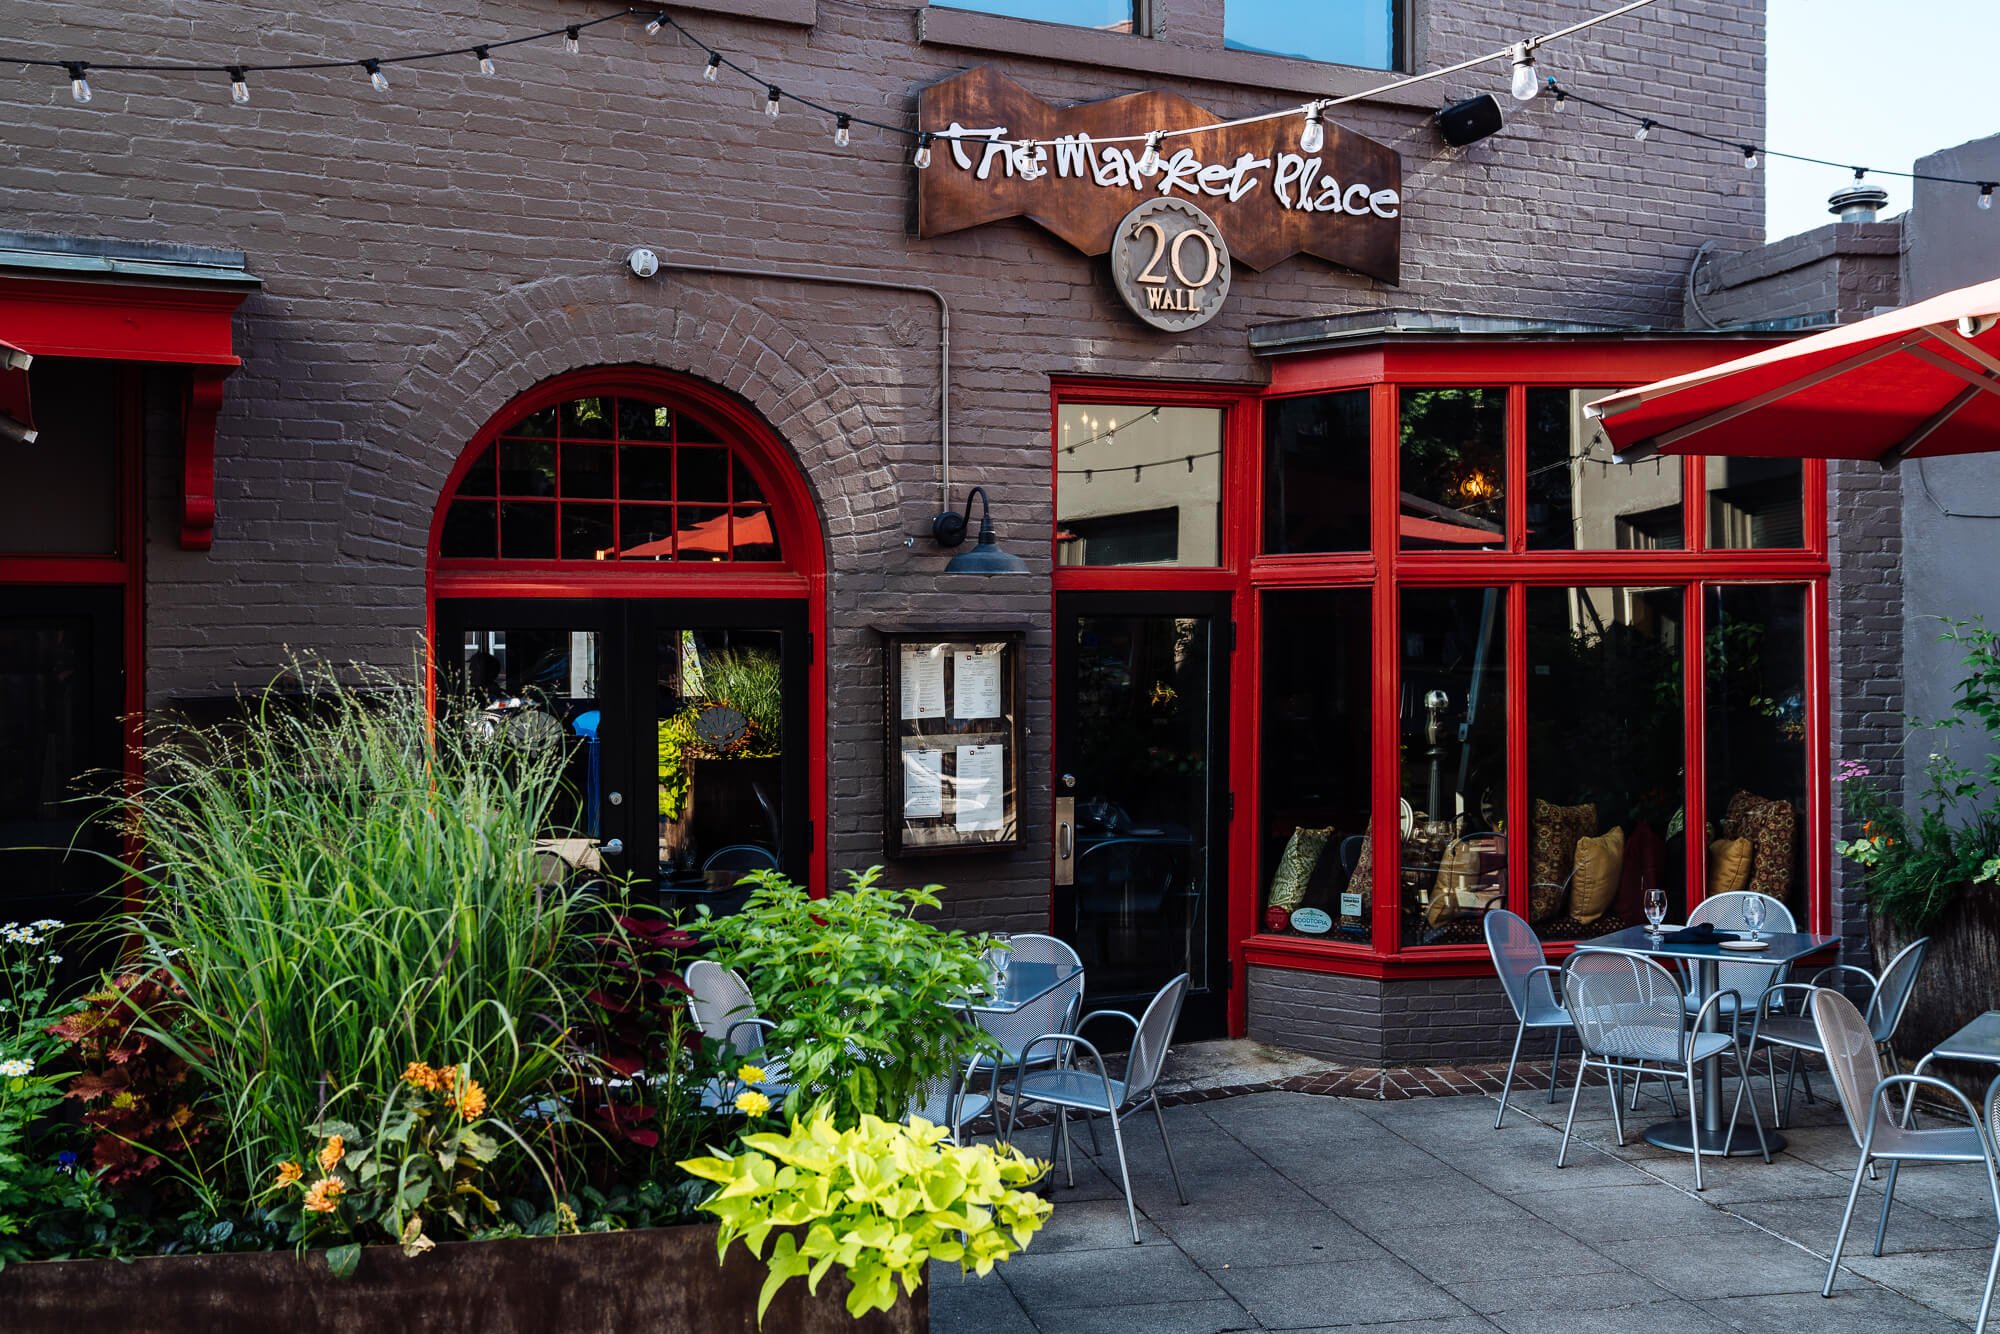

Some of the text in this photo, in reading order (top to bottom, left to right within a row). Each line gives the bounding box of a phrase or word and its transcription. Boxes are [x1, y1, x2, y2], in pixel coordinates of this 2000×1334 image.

[932, 122, 1400, 219] The Market Place
[1134, 222, 1218, 288] 20
[1145, 287, 1201, 312] WALL
